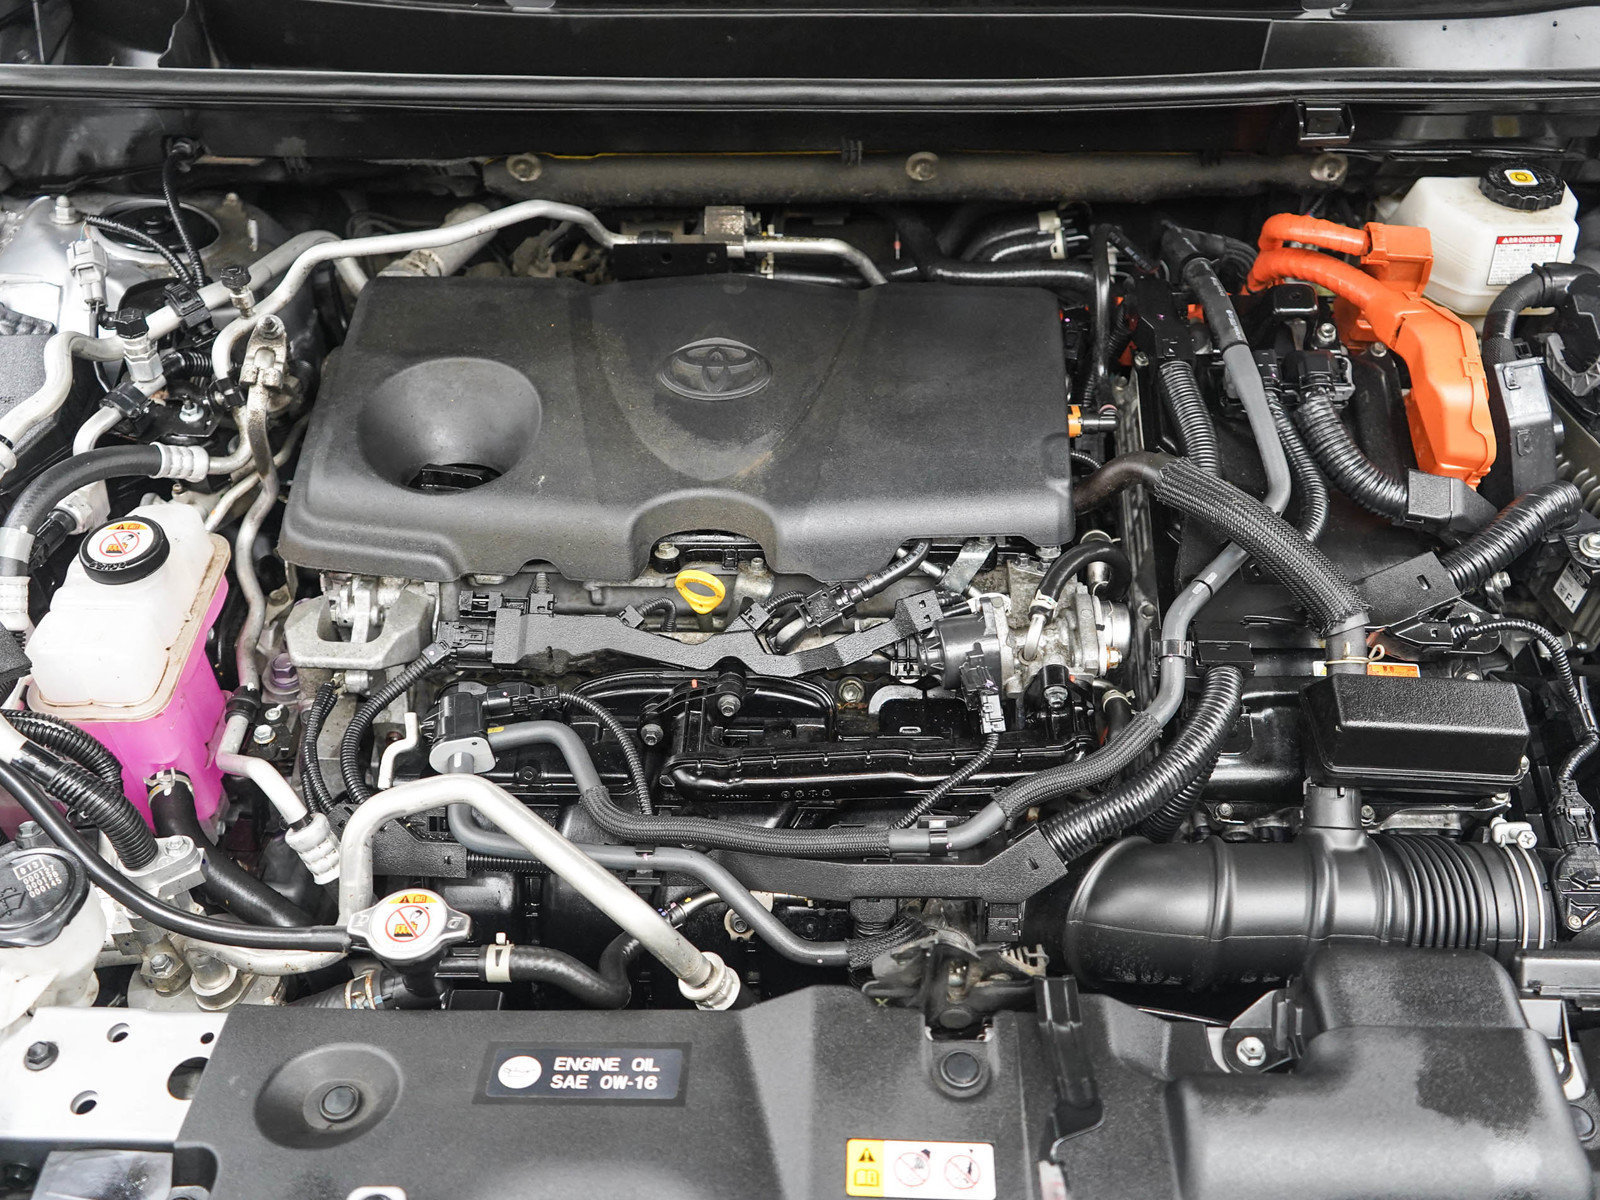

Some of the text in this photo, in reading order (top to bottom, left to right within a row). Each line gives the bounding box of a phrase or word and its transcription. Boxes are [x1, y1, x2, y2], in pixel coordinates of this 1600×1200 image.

[23, 864, 54, 885] 000127
[29, 877, 62, 898] 000145
[553, 1056, 660, 1072] ENGINE OIL
[550, 1074, 658, 1090] SAE 0W-16
